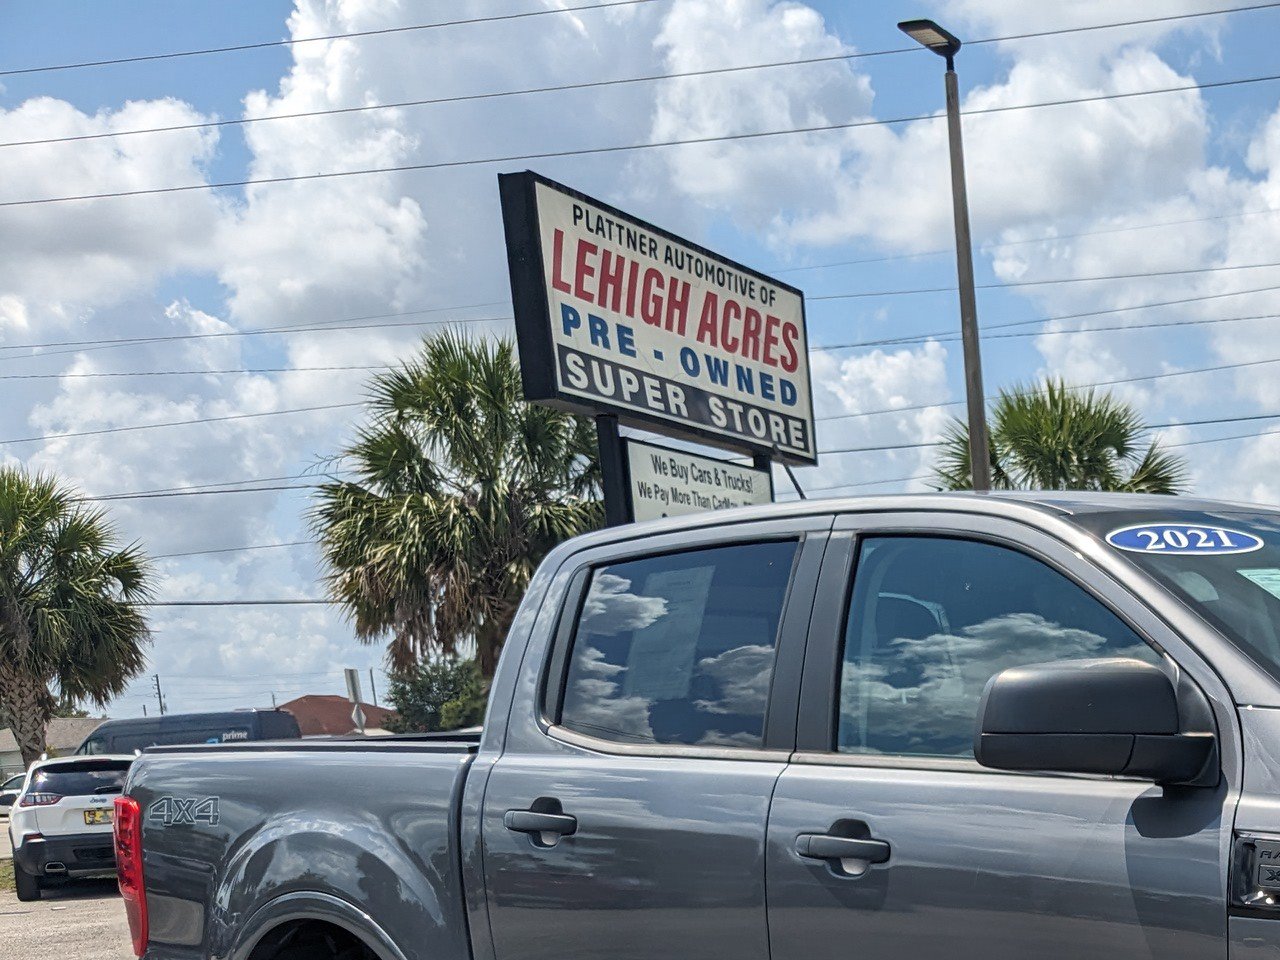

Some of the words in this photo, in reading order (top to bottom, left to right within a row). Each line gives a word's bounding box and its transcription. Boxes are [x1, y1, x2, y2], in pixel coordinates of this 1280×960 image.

[573, 204, 658, 260] PLATTNER
[664, 245, 755, 300] AUTOMOTIVE
[760, 286, 776, 307] OF
[552, 228, 691, 337] LEHIGH
[696, 291, 798, 373] ACRES
[565, 353, 689, 418] SUPER
[708, 396, 805, 449] STORE
[650, 454, 668, 477] We
[669, 458, 689, 485] Buy
[690, 463, 712, 485] Cars
[714, 468, 721, 486] &
[721, 470, 754, 494] Trucks!
[637, 481, 652, 499] We
[653, 484, 669, 505] Pay
[671, 487, 691, 506] More
[692, 491, 711, 510] Than
[1137, 529, 1238, 550] 2021
[222, 730, 248, 742] prime
